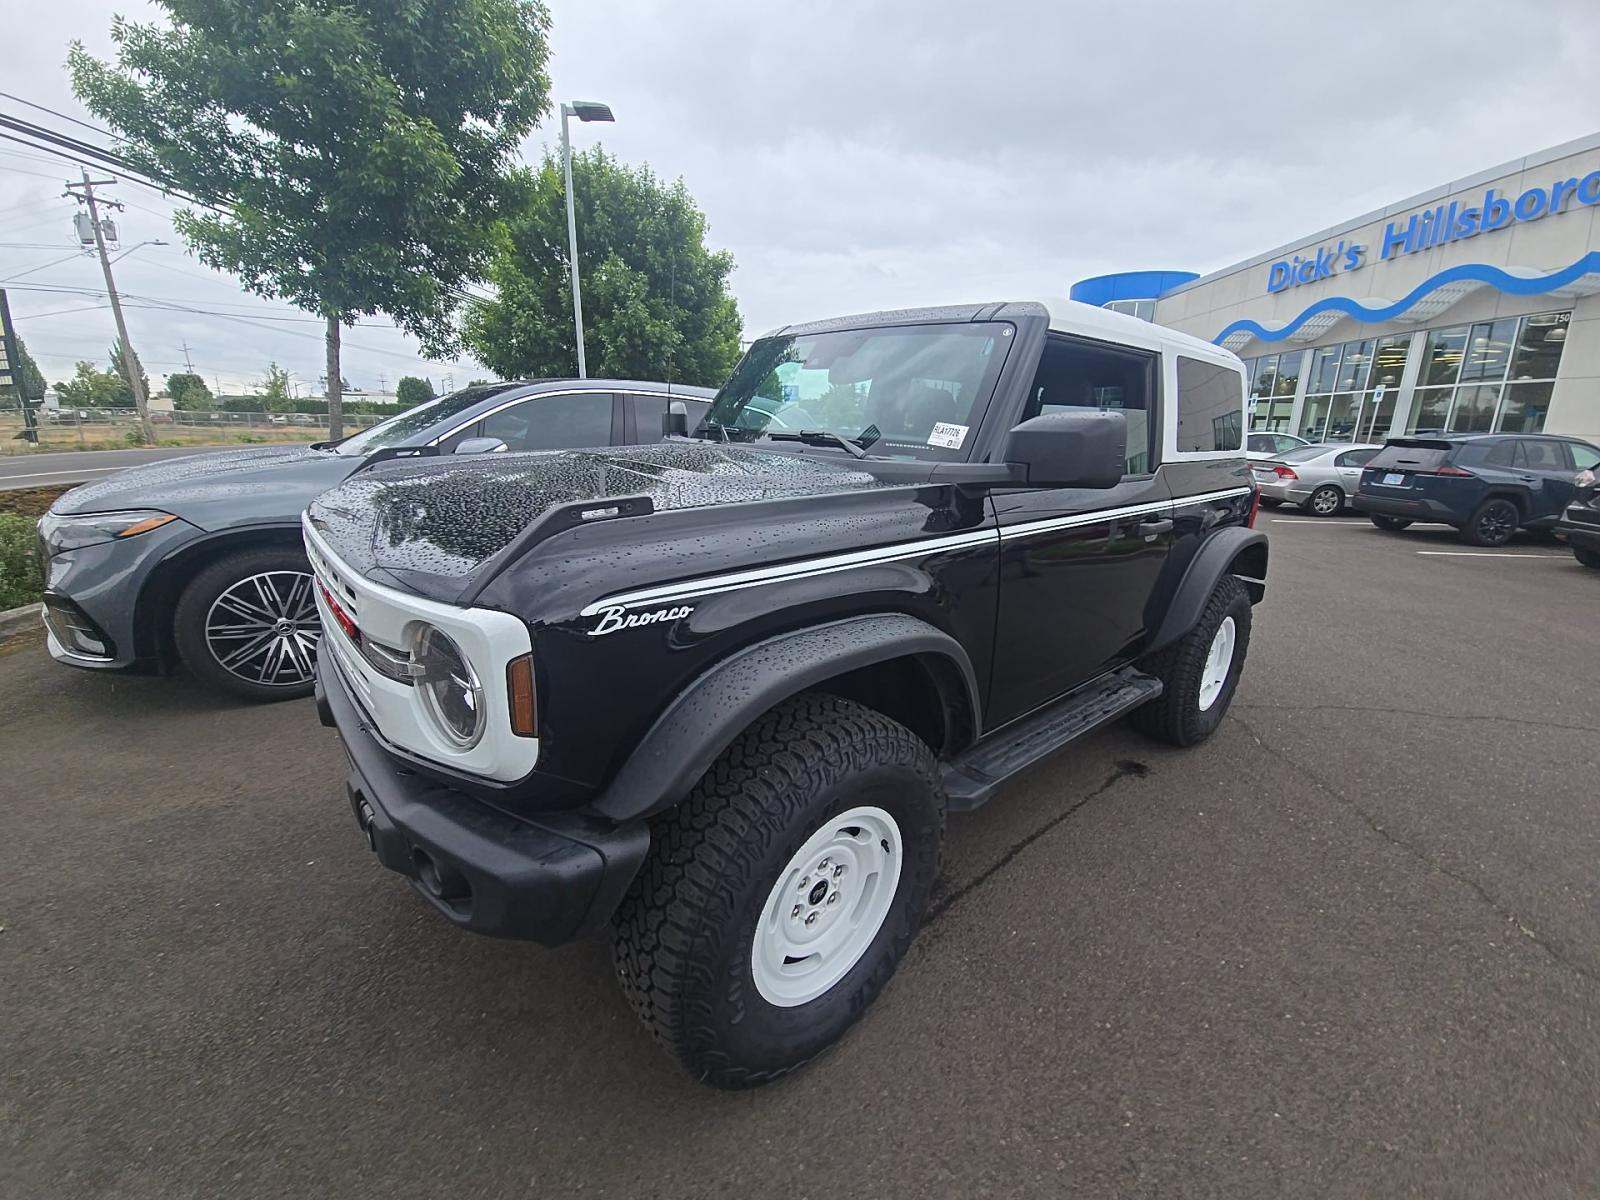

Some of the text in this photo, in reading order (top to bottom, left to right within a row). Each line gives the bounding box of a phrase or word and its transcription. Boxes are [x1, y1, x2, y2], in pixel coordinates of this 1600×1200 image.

[1267, 241, 1364, 293] Dick's
[1555, 313, 1571, 323] 750
[586, 605, 694, 636] Bronco
